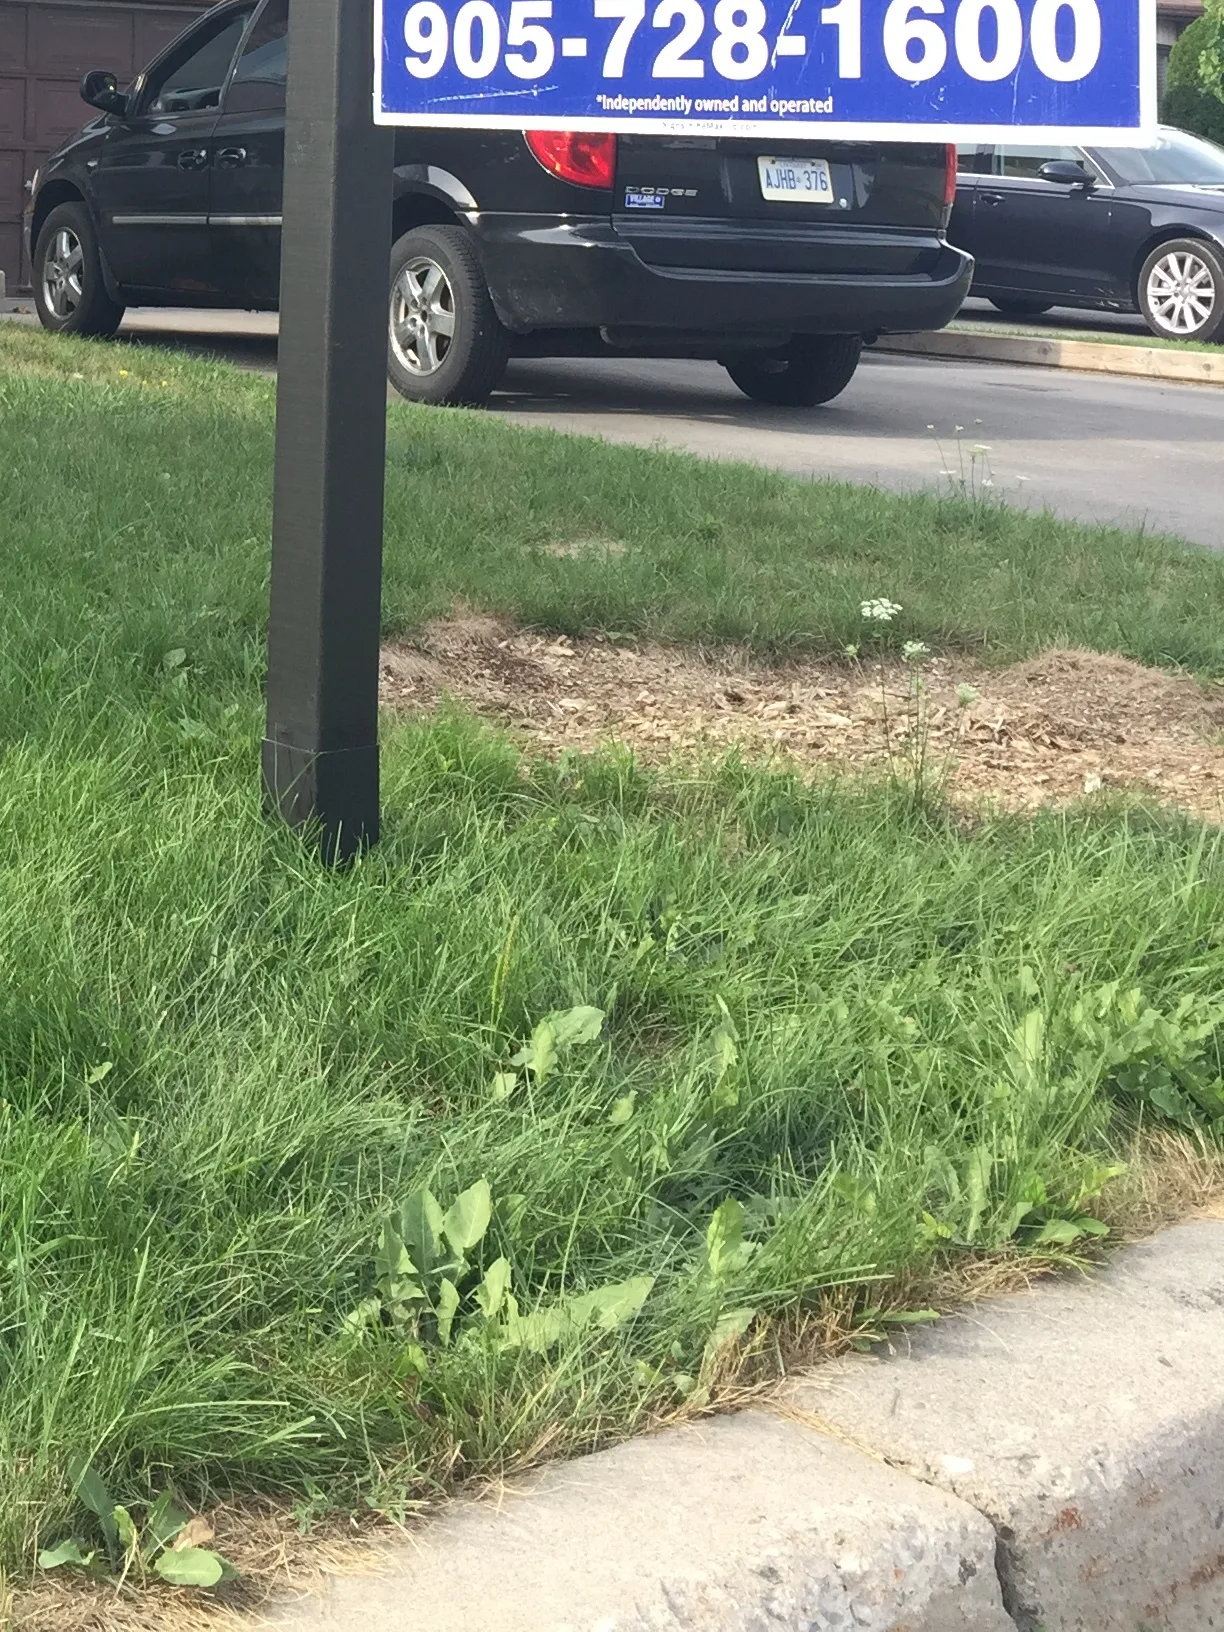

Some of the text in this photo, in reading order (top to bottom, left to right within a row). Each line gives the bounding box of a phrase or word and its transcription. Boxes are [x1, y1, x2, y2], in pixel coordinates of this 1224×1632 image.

[694, 96, 739, 113] owned
[741, 96, 767, 113] and
[770, 96, 833, 116] operated
[765, 168, 829, 191] AJHB 376
[625, 186, 698, 197] DODGE
